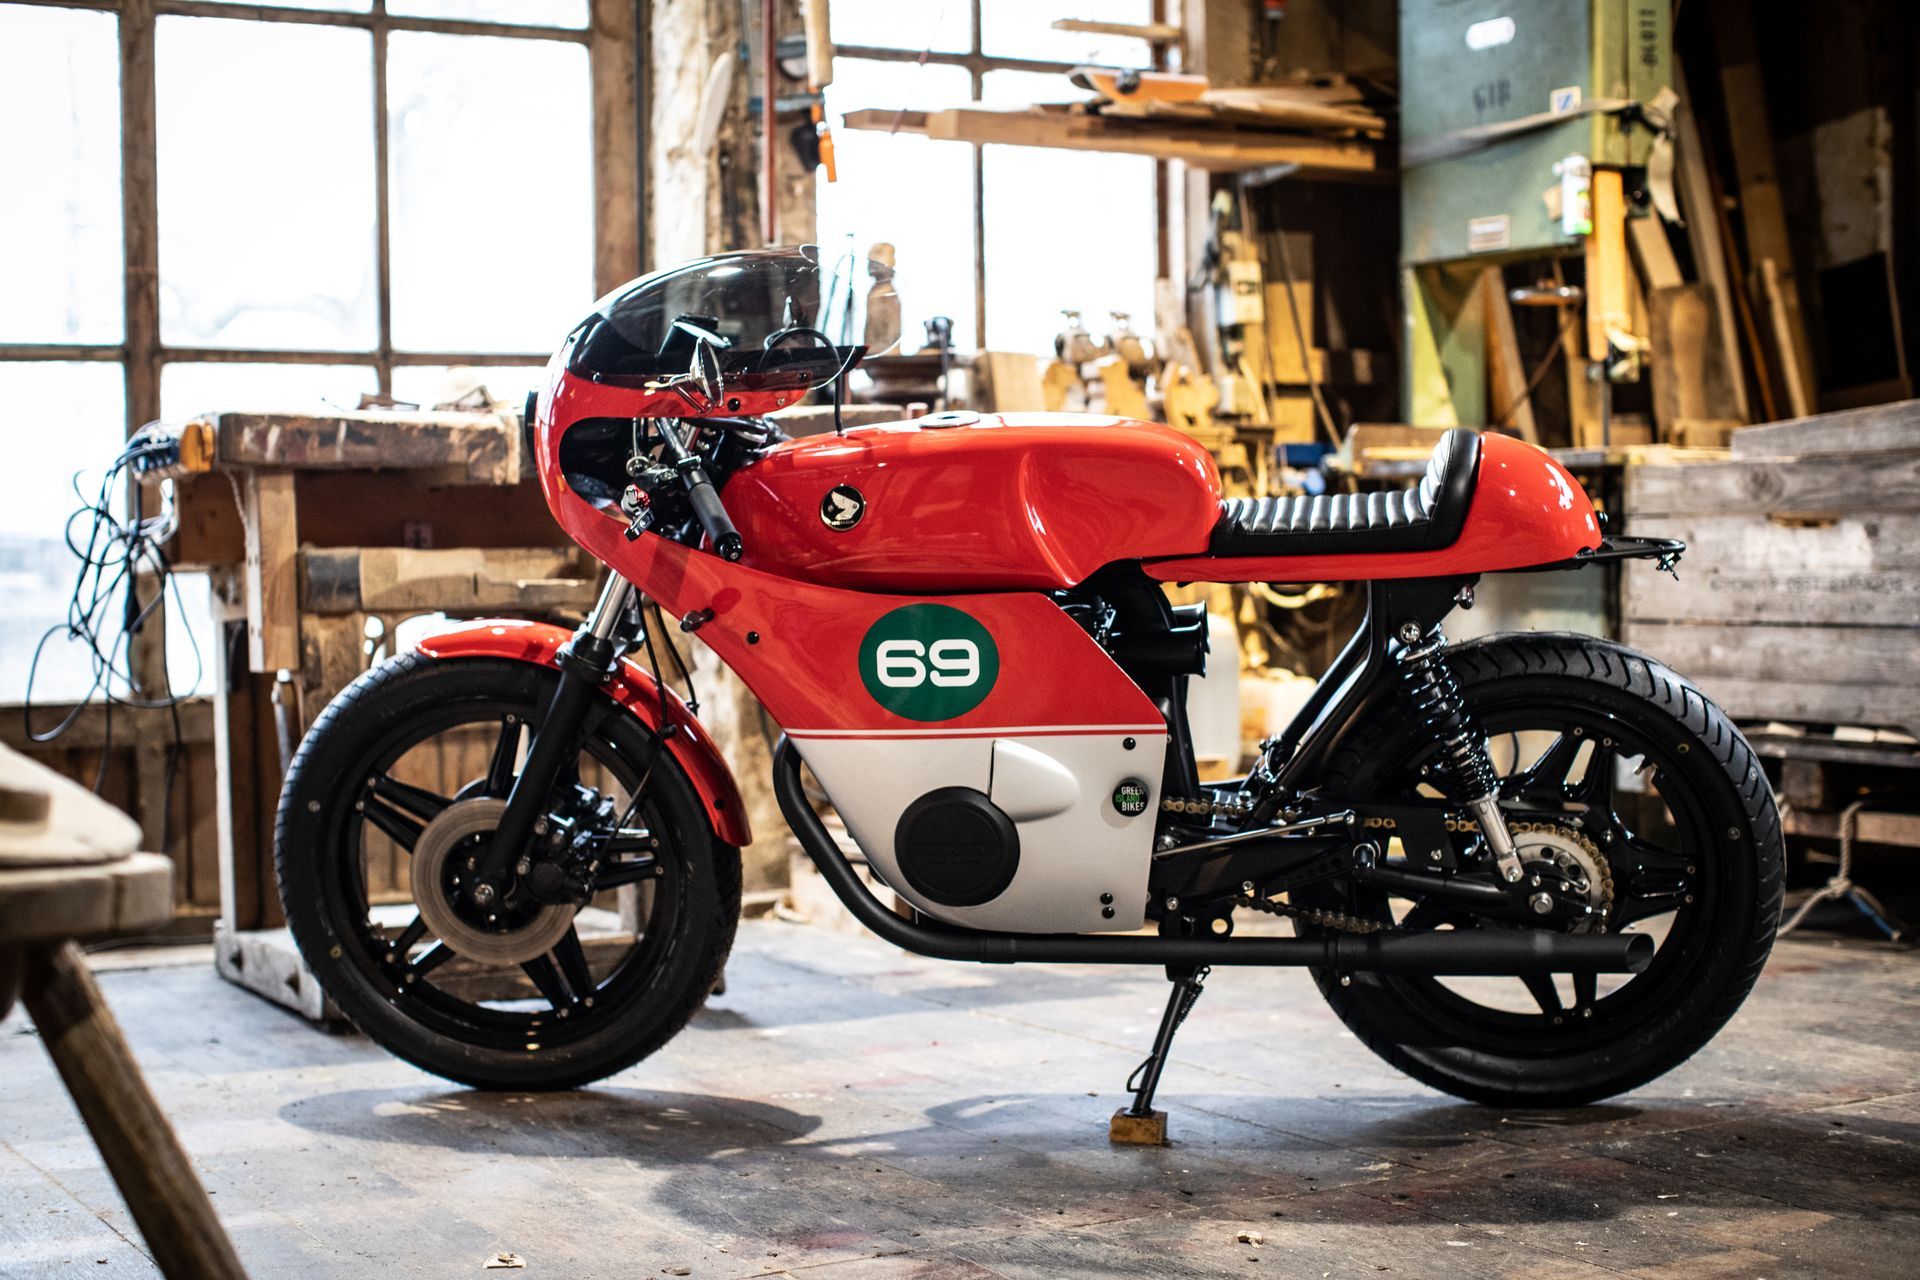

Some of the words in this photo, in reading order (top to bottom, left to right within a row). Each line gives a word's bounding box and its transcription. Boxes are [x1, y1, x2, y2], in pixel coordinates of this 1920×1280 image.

[876, 639, 980, 687] 69
[1121, 786, 1144, 795] GREEN
[1122, 802, 1145, 811] BIKES
